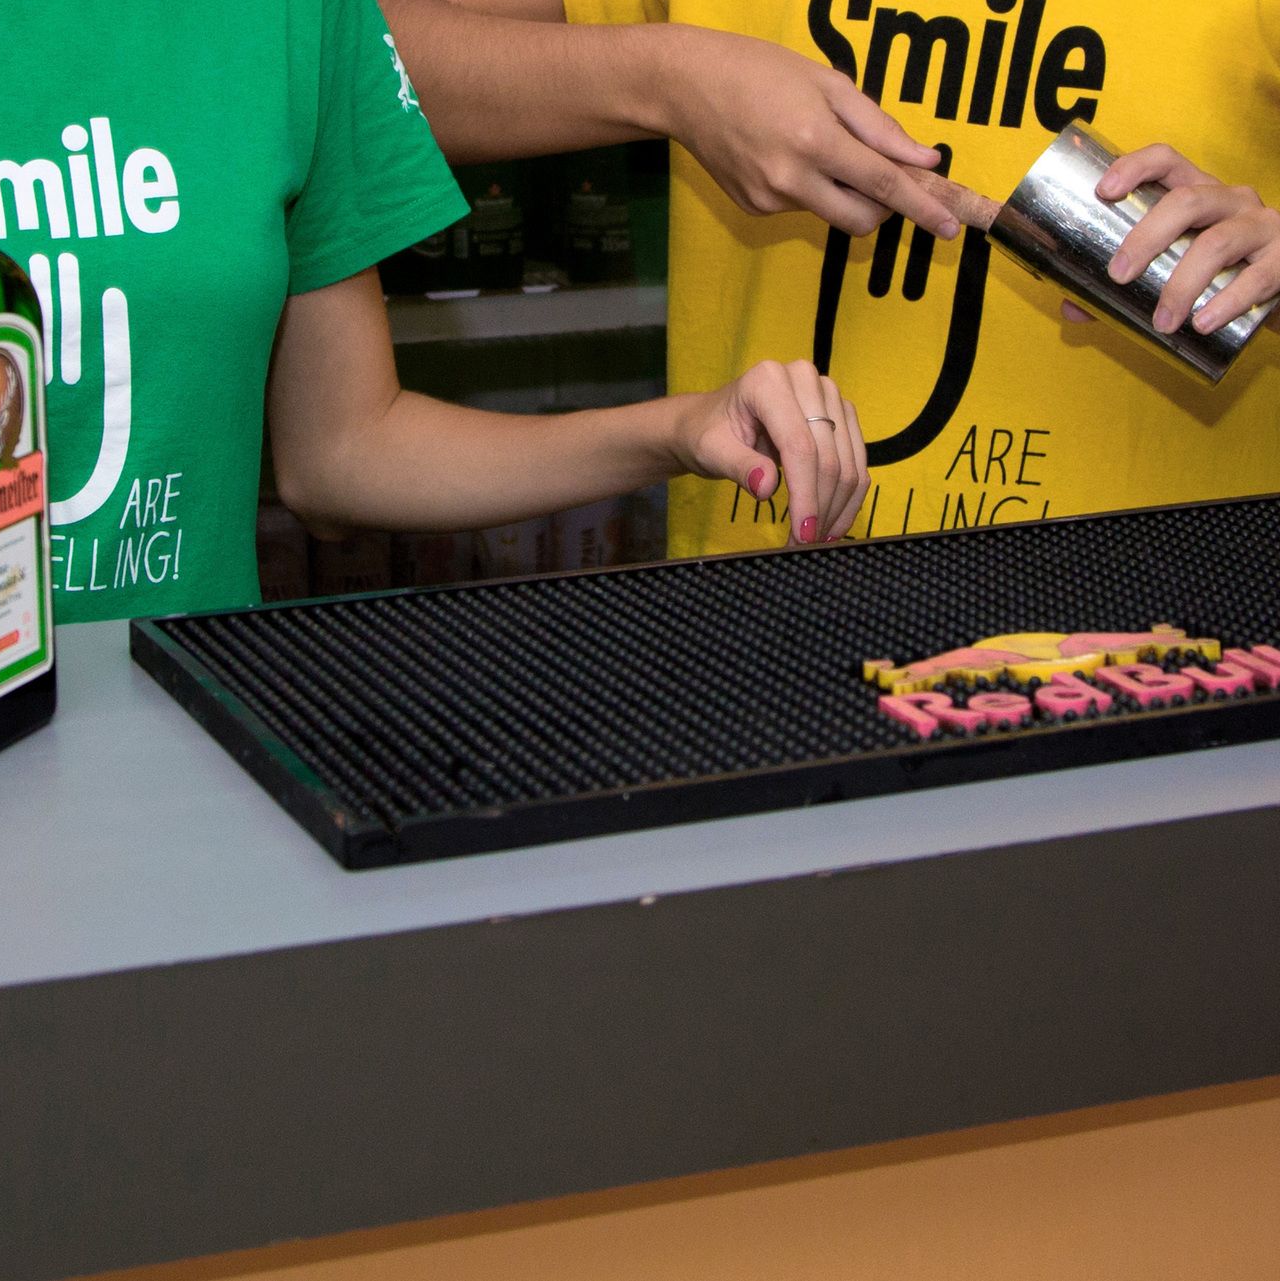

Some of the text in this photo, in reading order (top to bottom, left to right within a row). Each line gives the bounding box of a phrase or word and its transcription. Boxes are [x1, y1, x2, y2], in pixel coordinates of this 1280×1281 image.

[945, 424, 1051, 487] ARE
[120, 472, 184, 529] ARE
[878, 671, 1113, 738] Red
